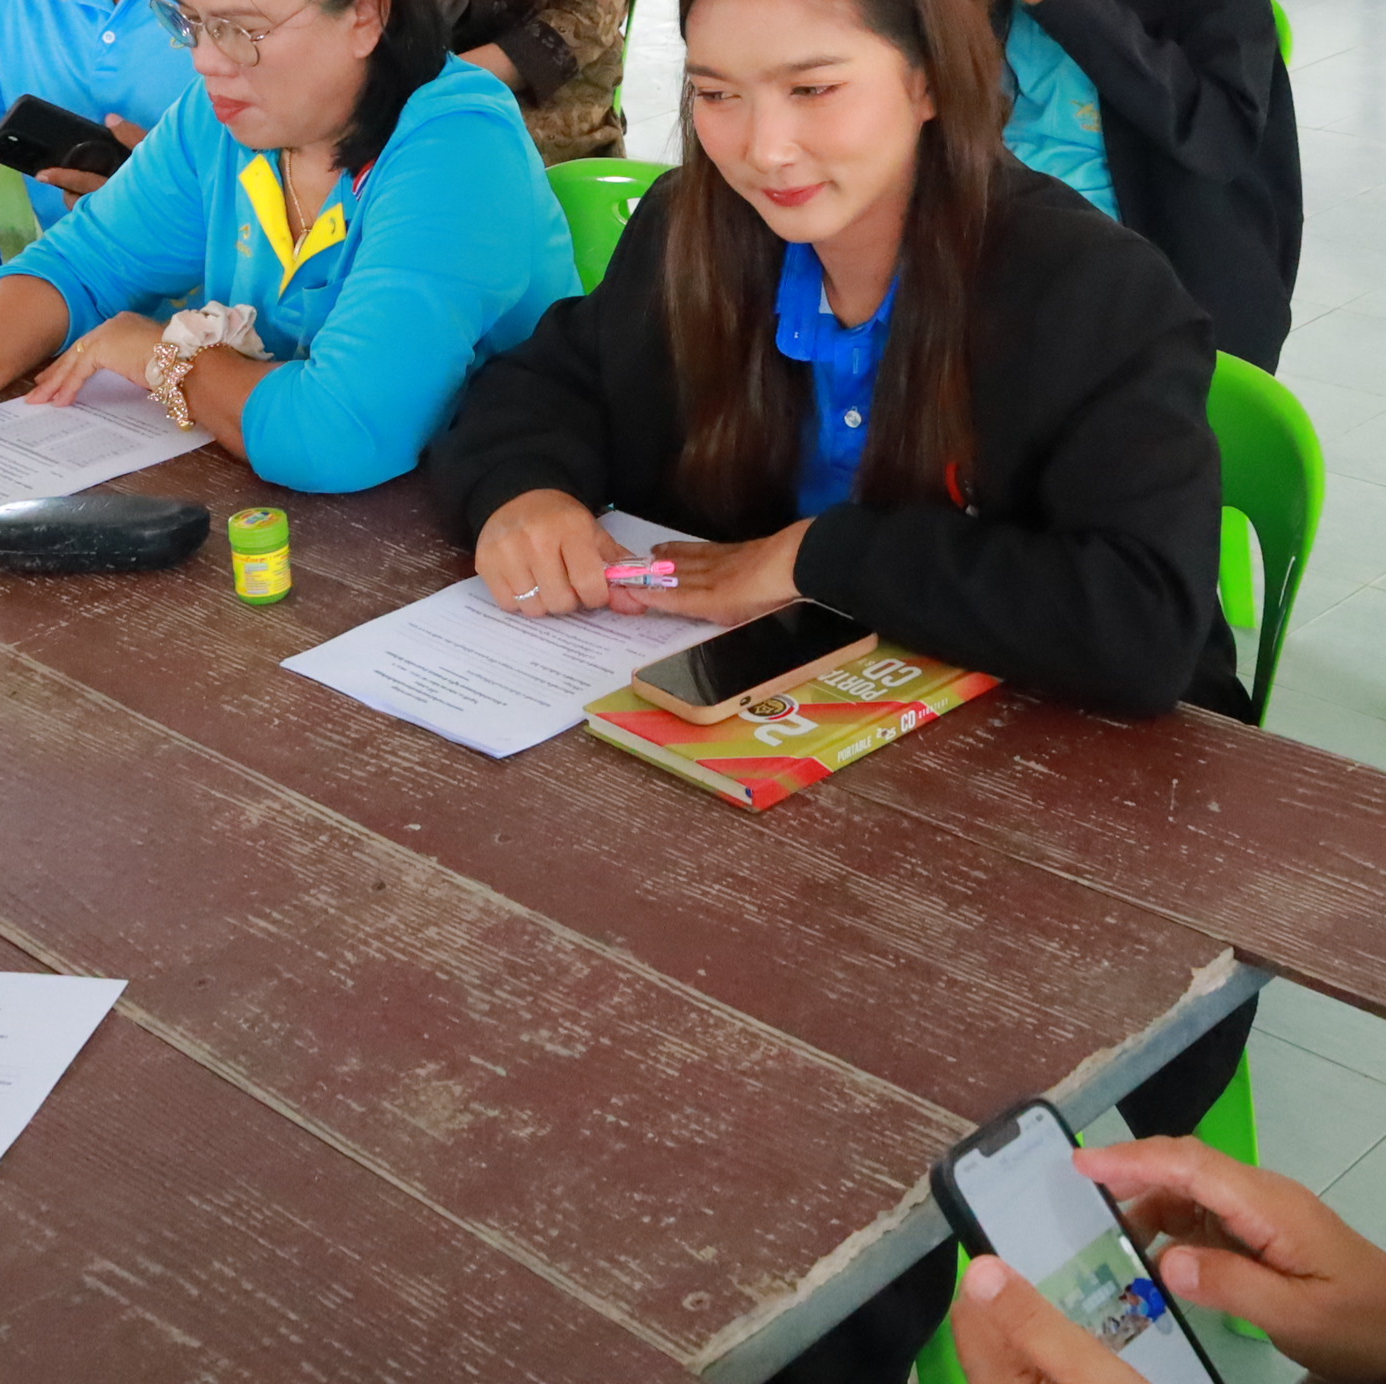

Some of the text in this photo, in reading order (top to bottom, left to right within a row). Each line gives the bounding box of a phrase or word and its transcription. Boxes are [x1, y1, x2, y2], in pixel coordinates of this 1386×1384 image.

[817, 669, 889, 702] PORTA
[862, 658, 923, 688] CD
[837, 735, 873, 764] PORTABLE
[900, 710, 917, 733] CD
